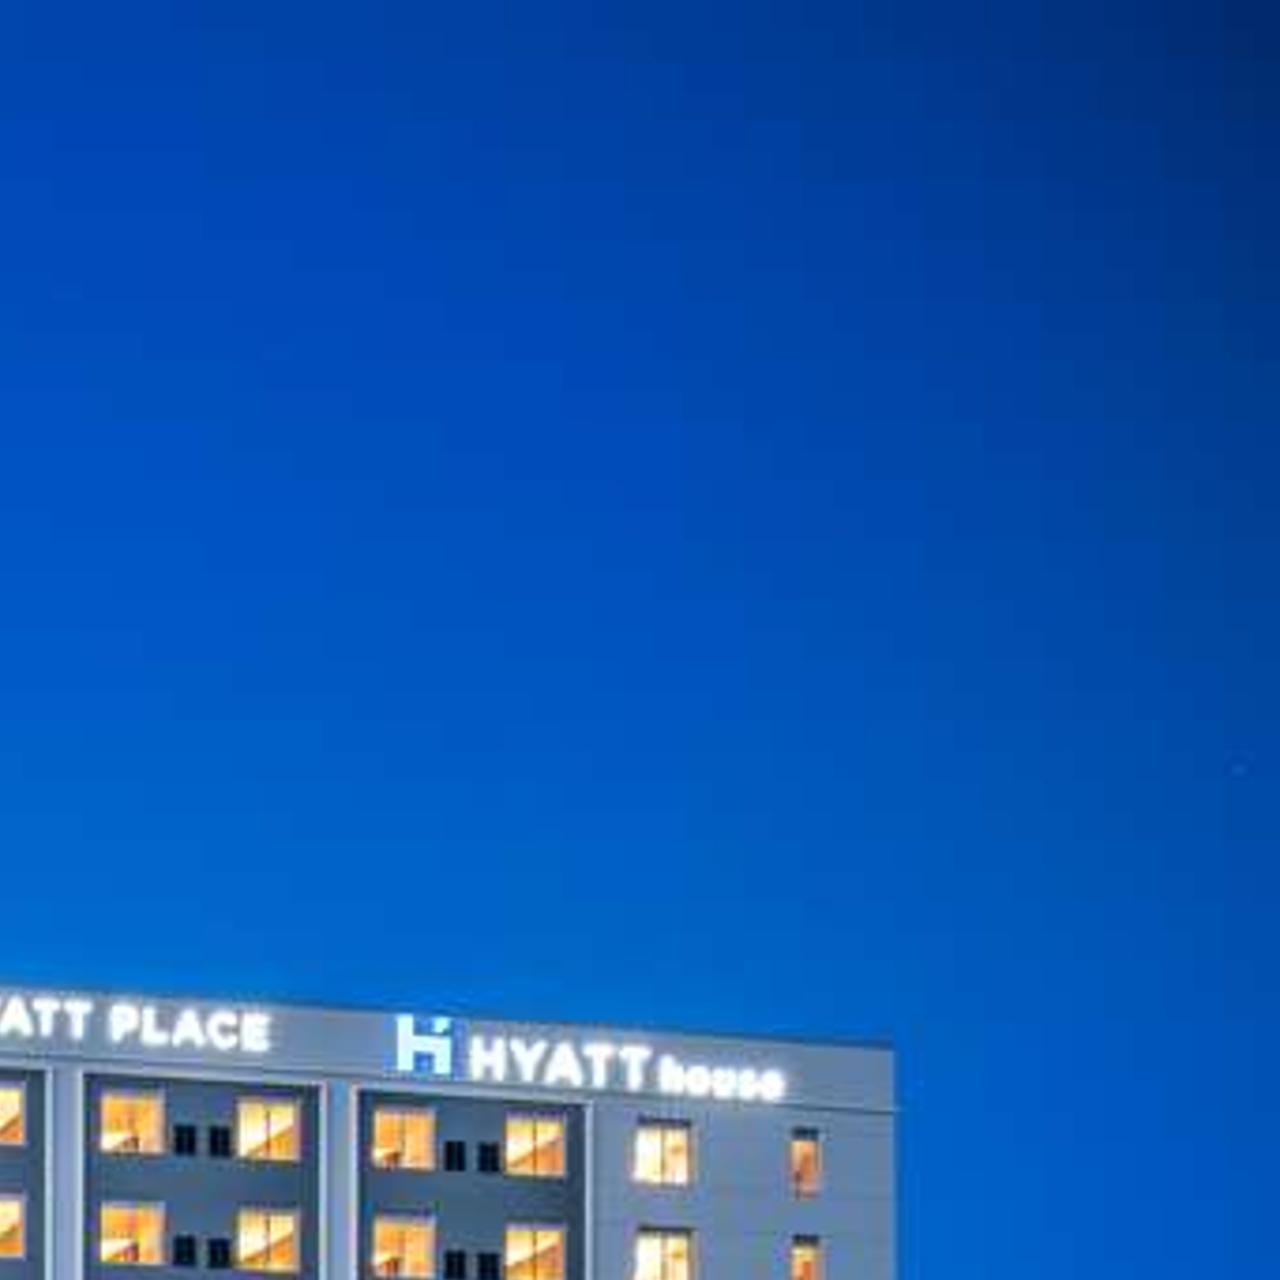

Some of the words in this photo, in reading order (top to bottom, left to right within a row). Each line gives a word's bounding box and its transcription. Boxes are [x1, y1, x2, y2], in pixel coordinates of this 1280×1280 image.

[109, 1003, 272, 1051] PLACE
[470, 1036, 651, 1090] HYATT
[658, 1055, 787, 1100] house
